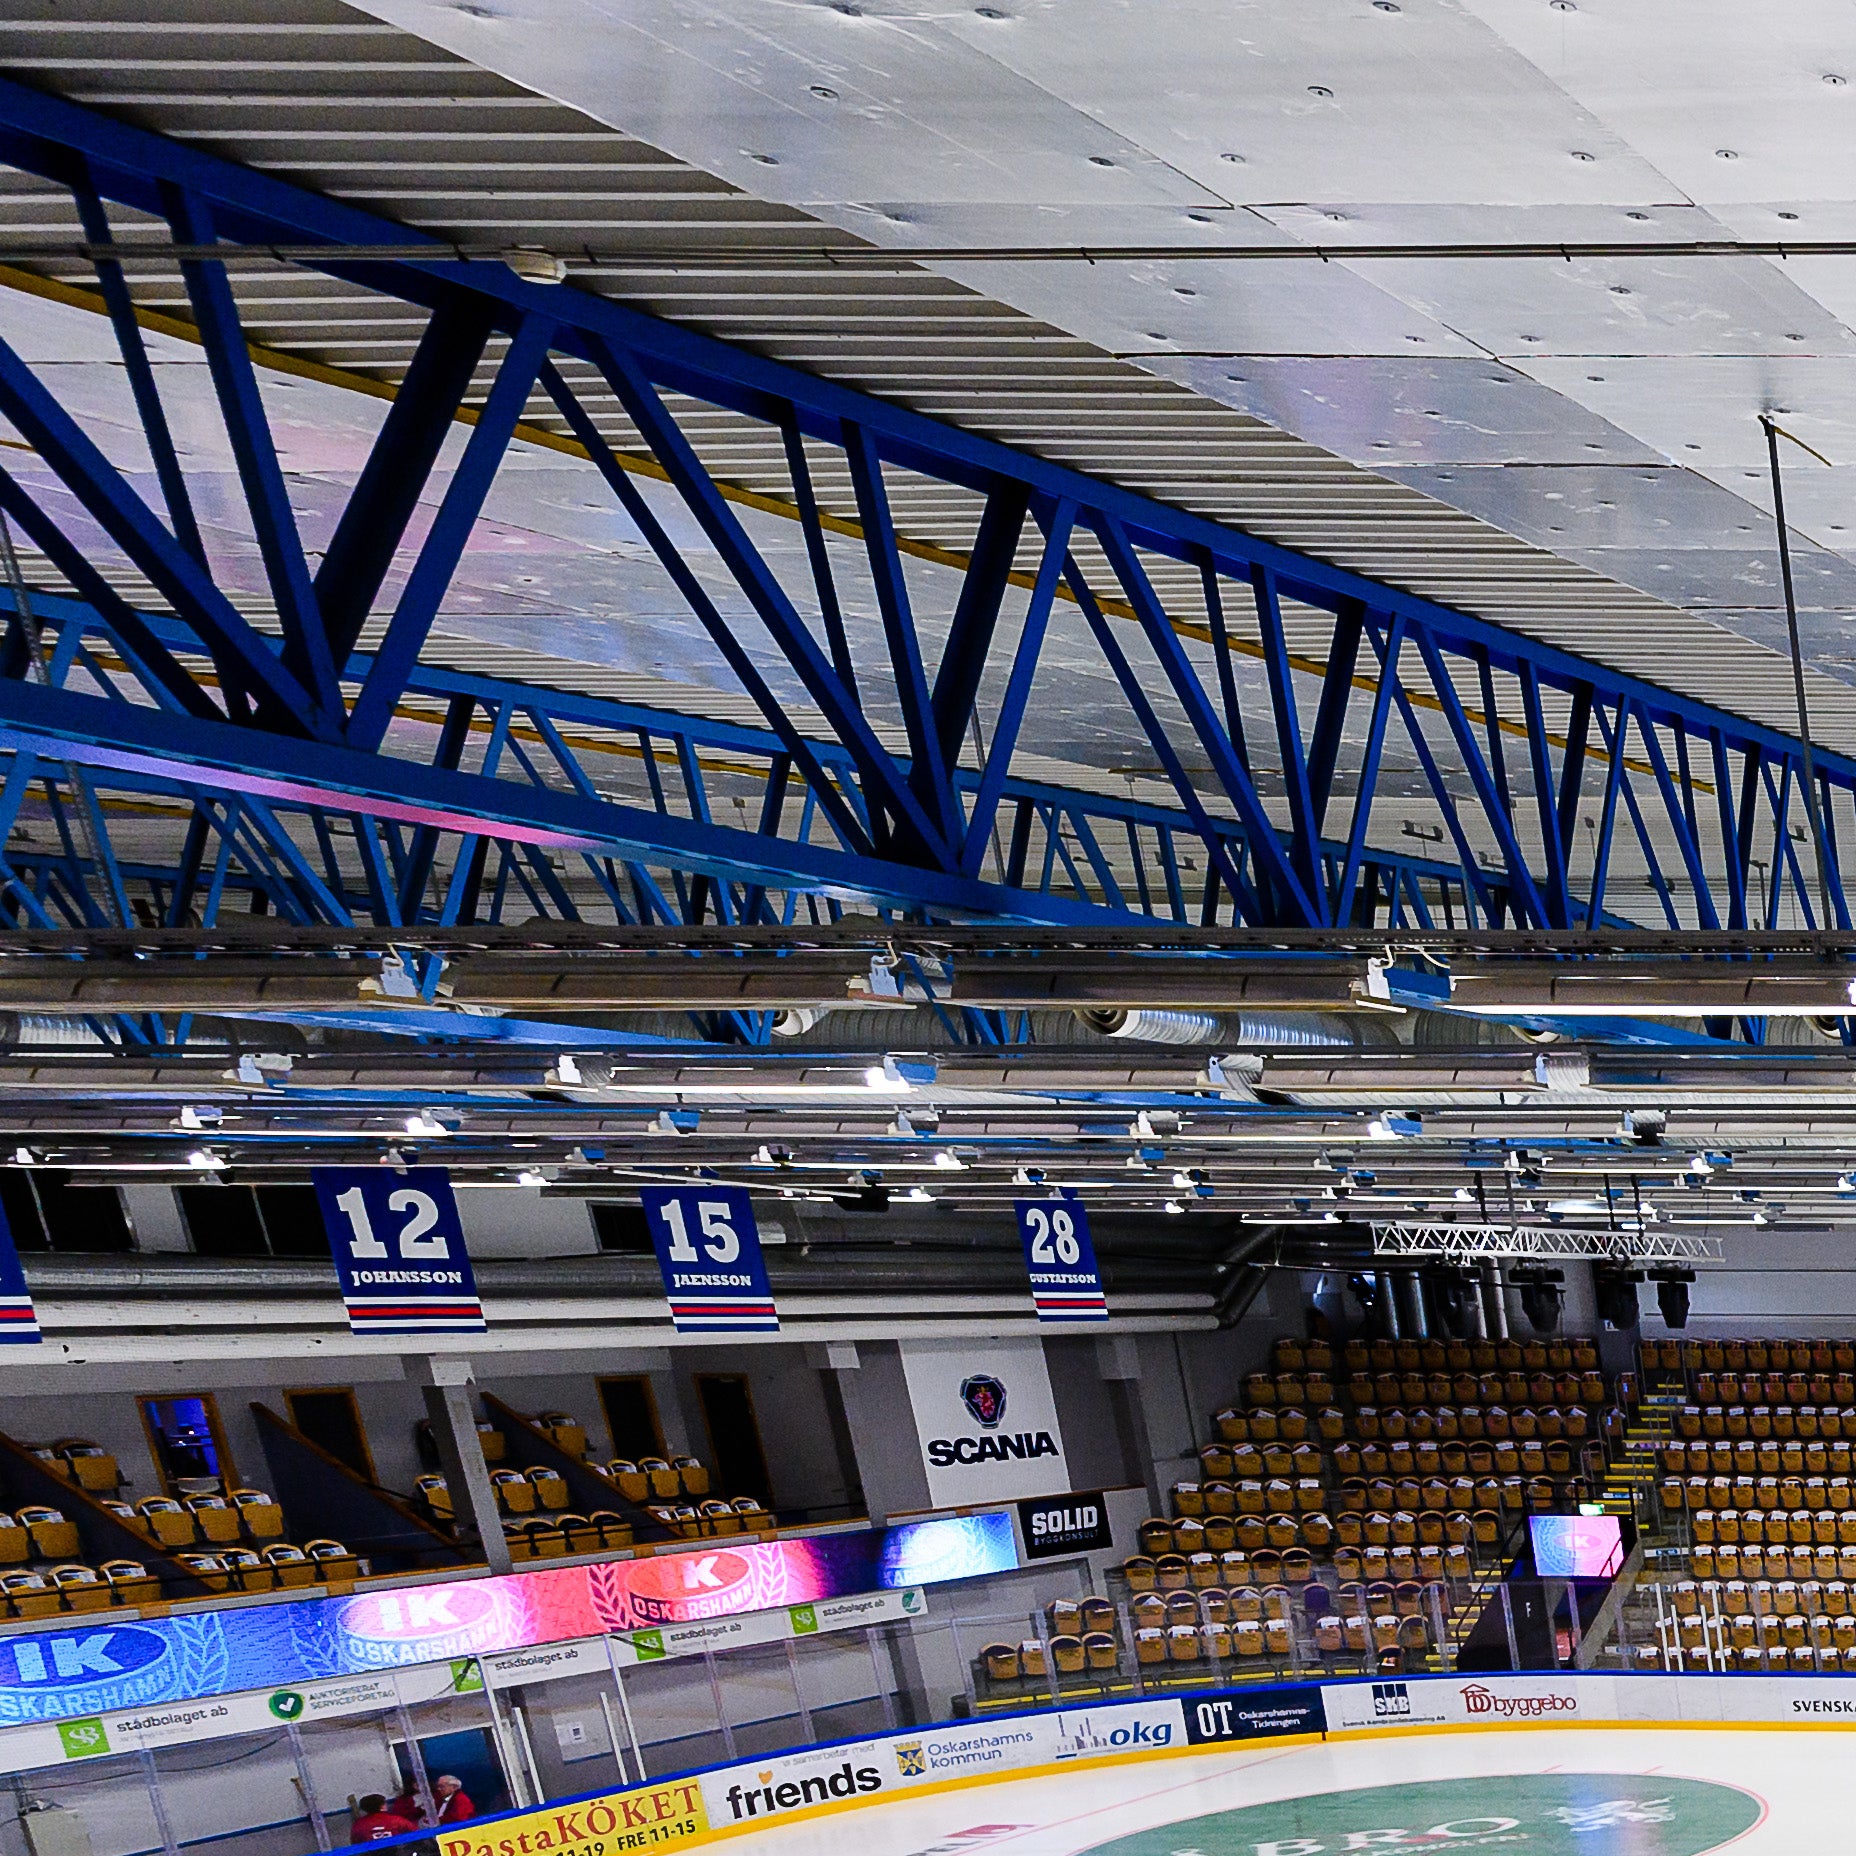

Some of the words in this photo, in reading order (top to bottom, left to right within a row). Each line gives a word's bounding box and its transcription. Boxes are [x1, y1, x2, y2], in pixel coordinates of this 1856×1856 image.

[336, 1187, 450, 1259] 12
[660, 1199, 740, 1263] 15
[1026, 1208, 1080, 1265] 28
[351, 1270, 462, 1286] JOHANSSON
[673, 1273, 752, 1288] JAENSSON
[1029, 1273, 1097, 1284] GUSTAFSSON
[928, 1432, 1059, 1467] SCANIA
[1032, 1505, 1098, 1536] SOLID
[378, 1589, 460, 1632] IK
[633, 1587, 752, 1621] OSKARSHAMN
[13, 1633, 124, 1682] IK
[348, 1621, 498, 1663] OSKARSHAMN
[117, 1708, 208, 1734] städbolaget
[211, 1705, 229, 1717] ab
[1196, 1701, 1233, 1737] OT
[1492, 1693, 1577, 1717] byggebo
[1109, 1721, 1173, 1748] okg
[1252, 1718, 1301, 1729] Tidningen
[928, 1731, 1034, 1755] Oskarshamns
[930, 1746, 1003, 1769] kommun
[726, 1761, 882, 1819] friends
[616, 1830, 648, 1852] FRE
[648, 1819, 696, 1843] 11-15
